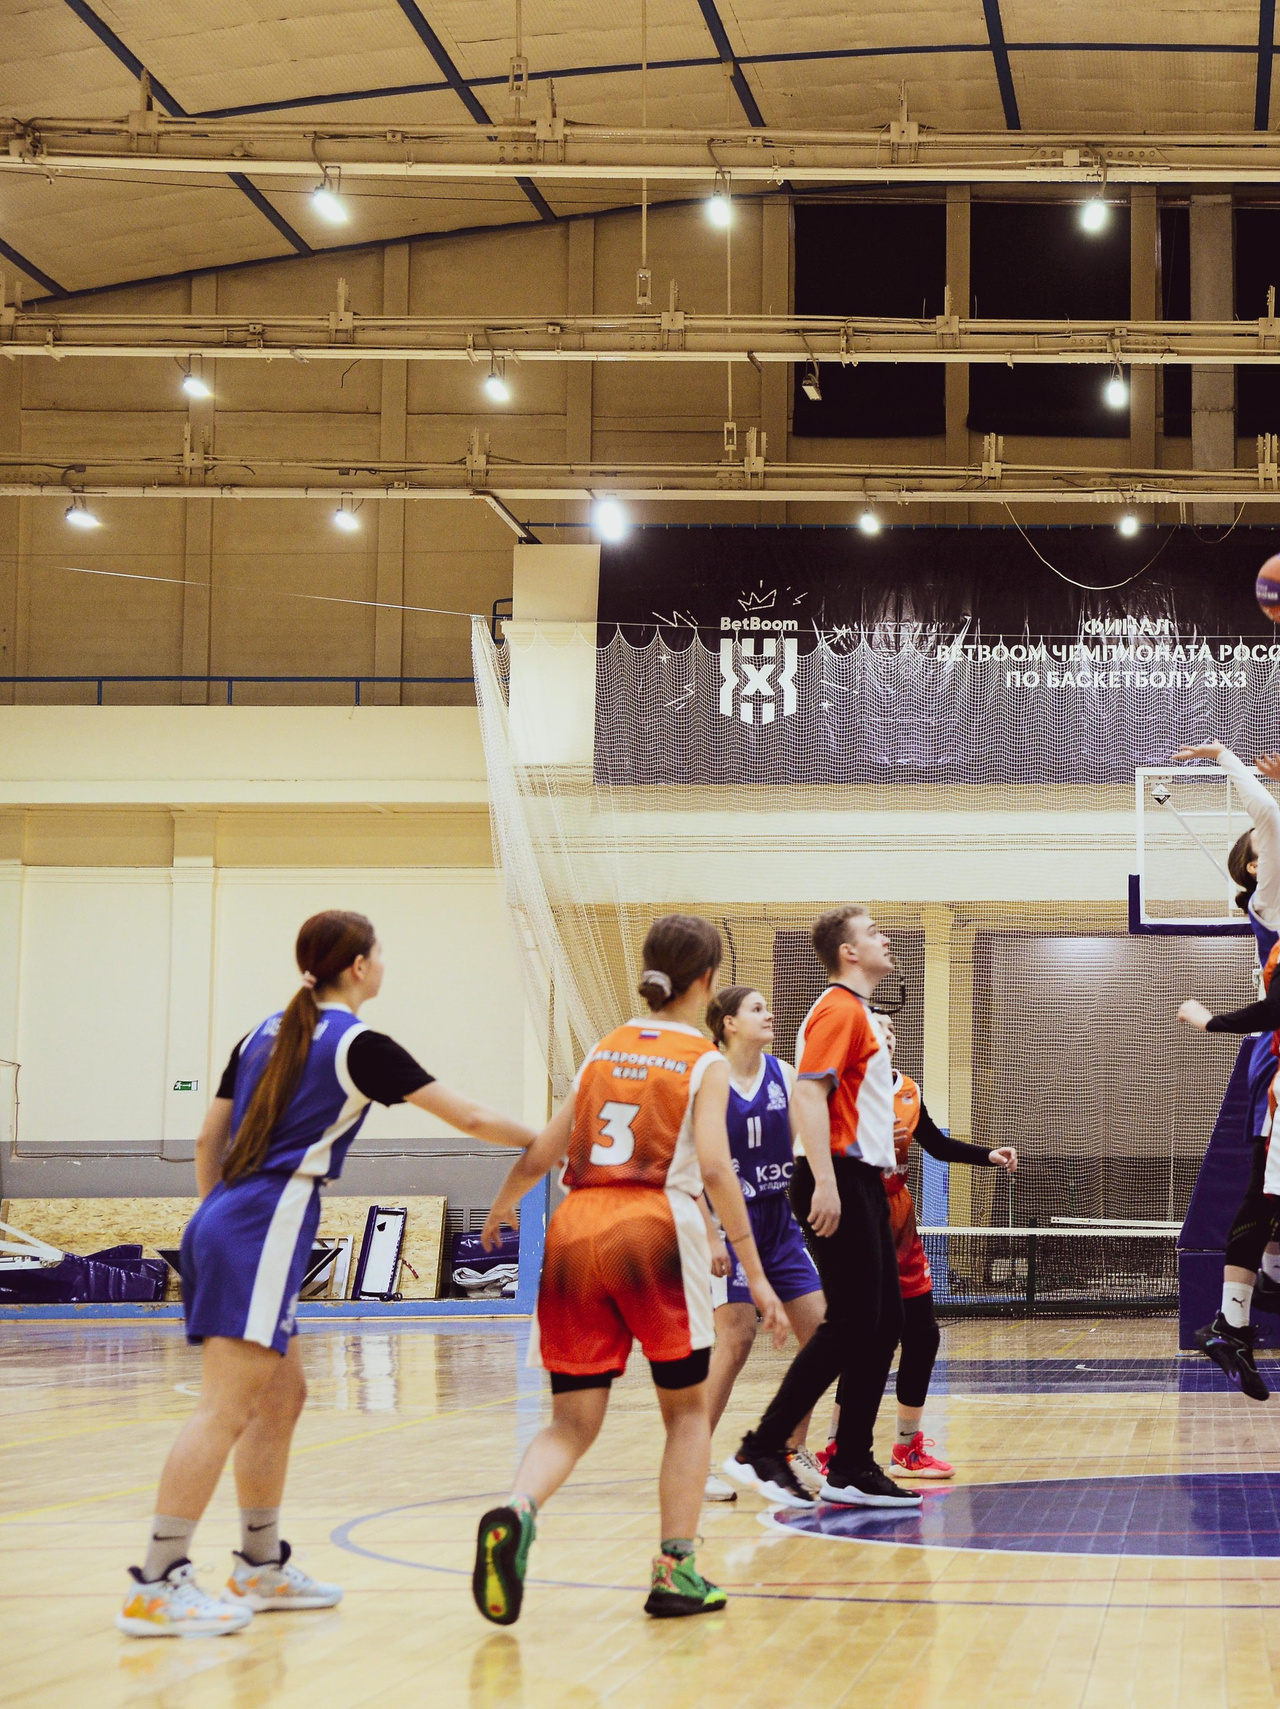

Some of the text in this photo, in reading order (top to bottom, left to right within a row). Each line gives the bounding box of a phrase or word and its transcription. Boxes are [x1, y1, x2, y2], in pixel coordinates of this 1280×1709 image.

[720, 617, 799, 631] BetBoom
[1084, 618, 1170, 636] ФИНАЛ
[1052, 644, 1214, 662] ЧЕМПИОНАТА
[1006, 671, 1040, 688] ПО
[1046, 671, 1199, 688] БАСКЕТБОЛУ
[592, 1049, 688, 1075] АБАРОВСКИЙ
[612, 1065, 648, 1081] КРАЙ
[589, 1100, 641, 1167] 3
[746, 1115, 763, 1149] 11
[755, 1161, 794, 1182] КЭС
